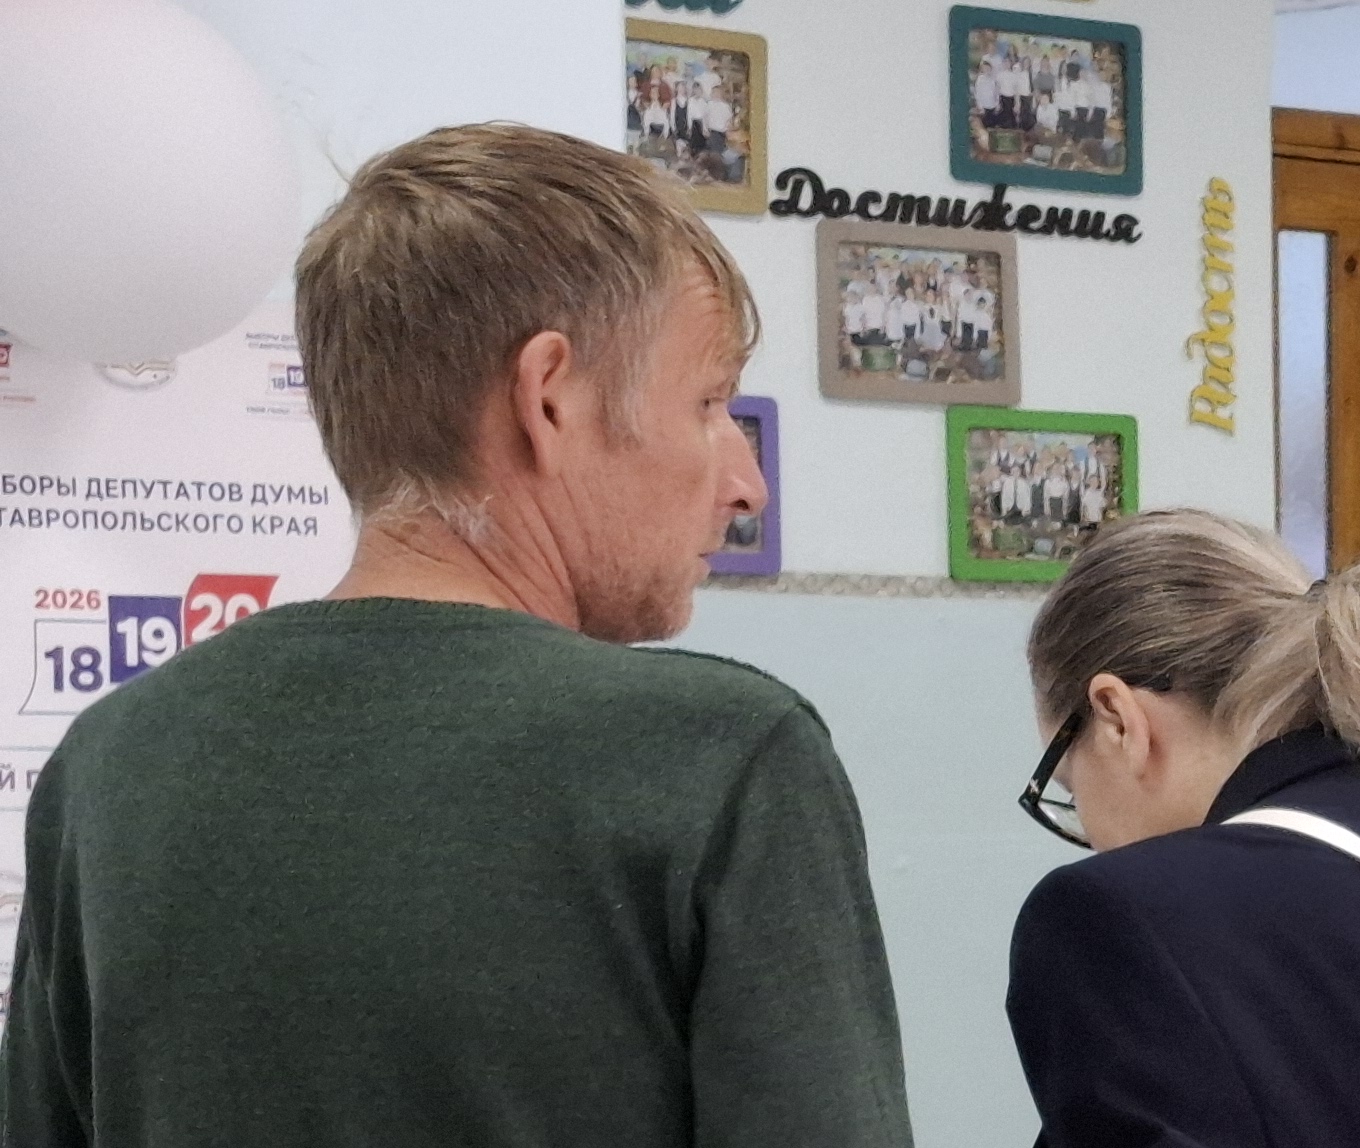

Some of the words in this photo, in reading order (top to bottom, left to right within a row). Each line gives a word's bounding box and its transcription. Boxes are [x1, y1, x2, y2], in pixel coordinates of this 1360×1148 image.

[769, 167, 1142, 243] Достижения
[1185, 176, 1236, 436] Радость
[1, 475, 76, 497] БОРЫ
[85, 477, 243, 502] ДЕПУТАТОВ
[250, 483, 329, 505] ДУМЫ
[251, 515, 319, 536] КРАЯ
[34, 589, 101, 610] 2026
[44, 646, 104, 693] 18
[116, 616, 177, 668] 19
